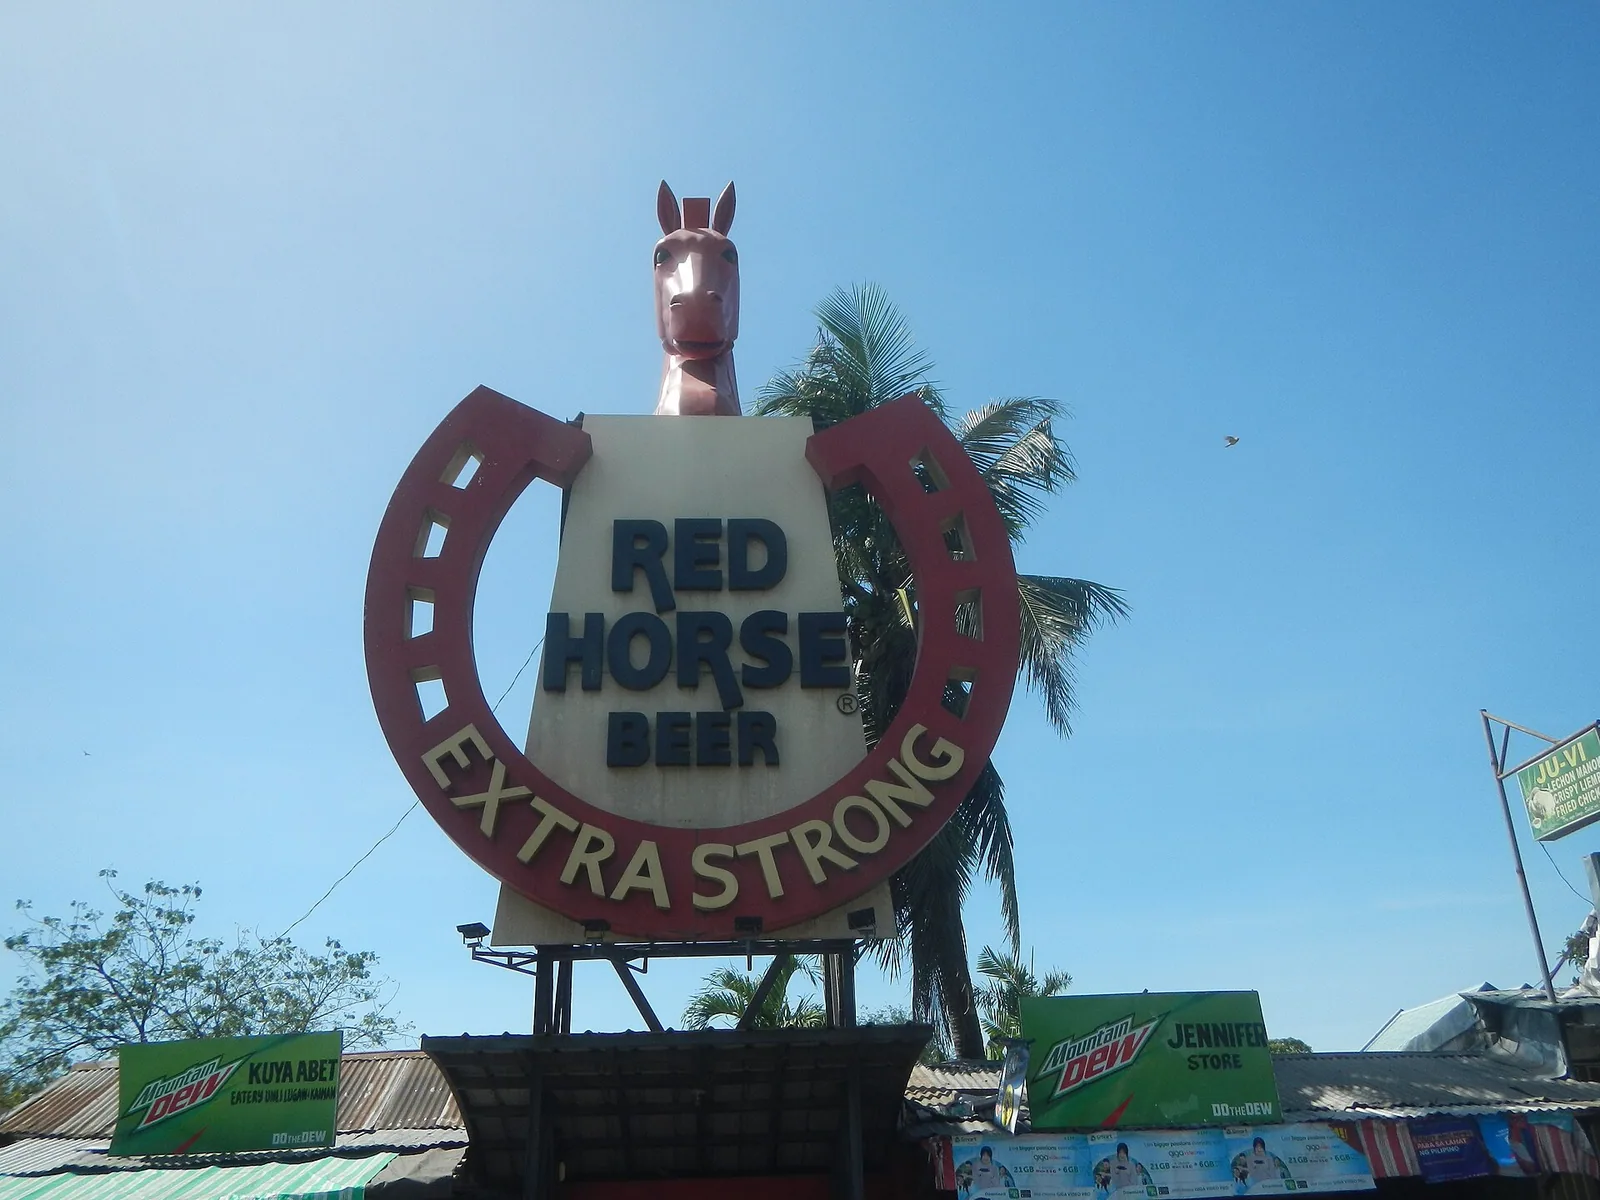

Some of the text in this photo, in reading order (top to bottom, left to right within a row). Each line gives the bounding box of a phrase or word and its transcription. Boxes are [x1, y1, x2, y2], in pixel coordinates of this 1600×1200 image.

[610, 518, 787, 614] RED
[543, 610, 850, 711] HORSE
[606, 711, 779, 768] BEER
[1537, 742, 1586, 783] JU-VI
[1547, 770, 1577, 792] LECHON
[1553, 783, 1579, 804] CRISPY
[421, 723, 966, 911] EXTRA STRONG
[1555, 799, 1577, 818] FRIED
[1049, 1020, 1129, 1068] Mountain
[1168, 1023, 1268, 1048] JENNIFER
[249, 1059, 338, 1084] KUYA ABET
[1188, 1054, 1242, 1070] STORE
[135, 1062, 216, 1104] Mountain
[231, 1090, 263, 1105] EATERY
[1417, 1141, 1435, 1149] PARA
[1445, 1138, 1467, 1146] LAHAT
[1431, 1146, 1459, 1155] PILIPINO
[1150, 1162, 1170, 1170] 21GB
[1199, 1160, 1215, 1168] 6GB
